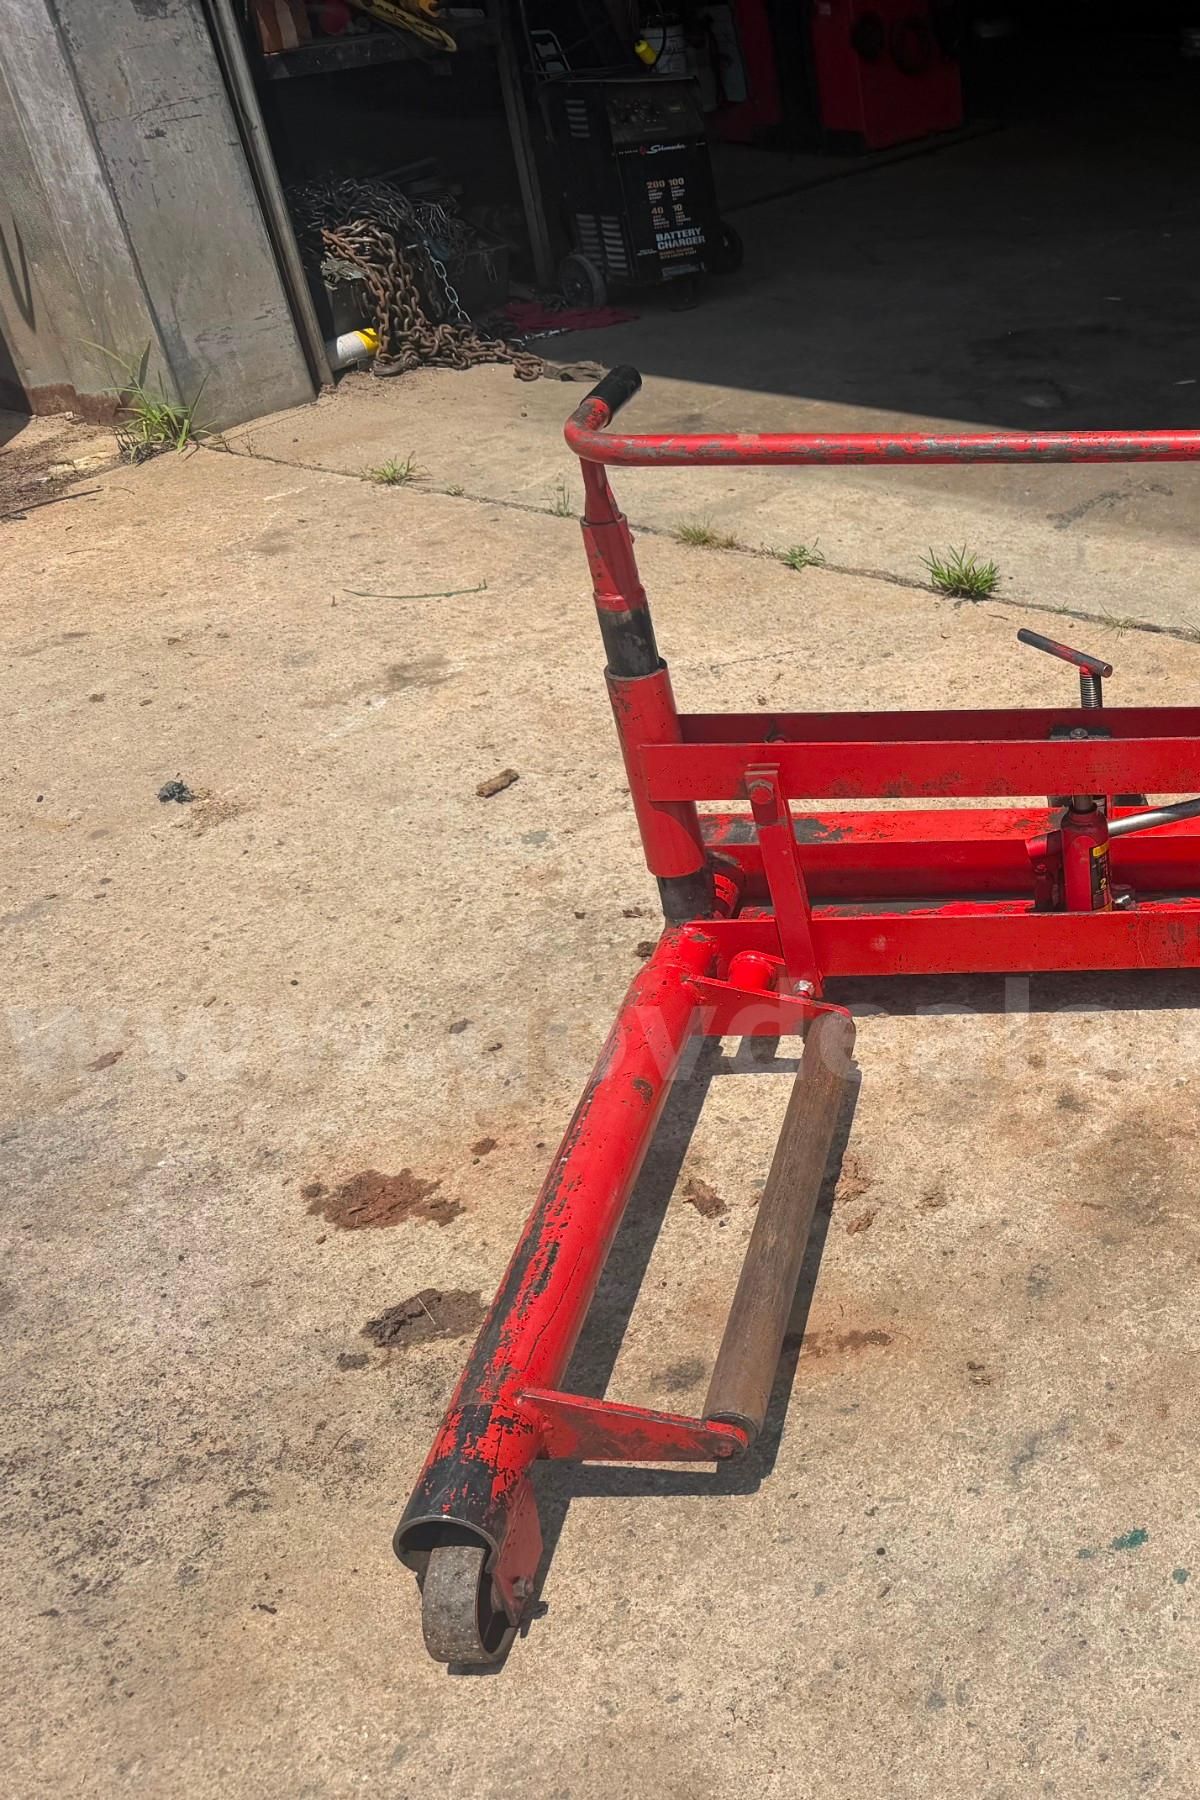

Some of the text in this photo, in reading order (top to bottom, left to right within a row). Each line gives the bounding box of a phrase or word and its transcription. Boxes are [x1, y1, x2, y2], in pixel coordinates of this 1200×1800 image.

[646, 177, 685, 189] 200 100
[651, 203, 683, 215] 40 10
[655, 227, 702, 242] BATTERY
[657, 236, 705, 250] CHARGER
